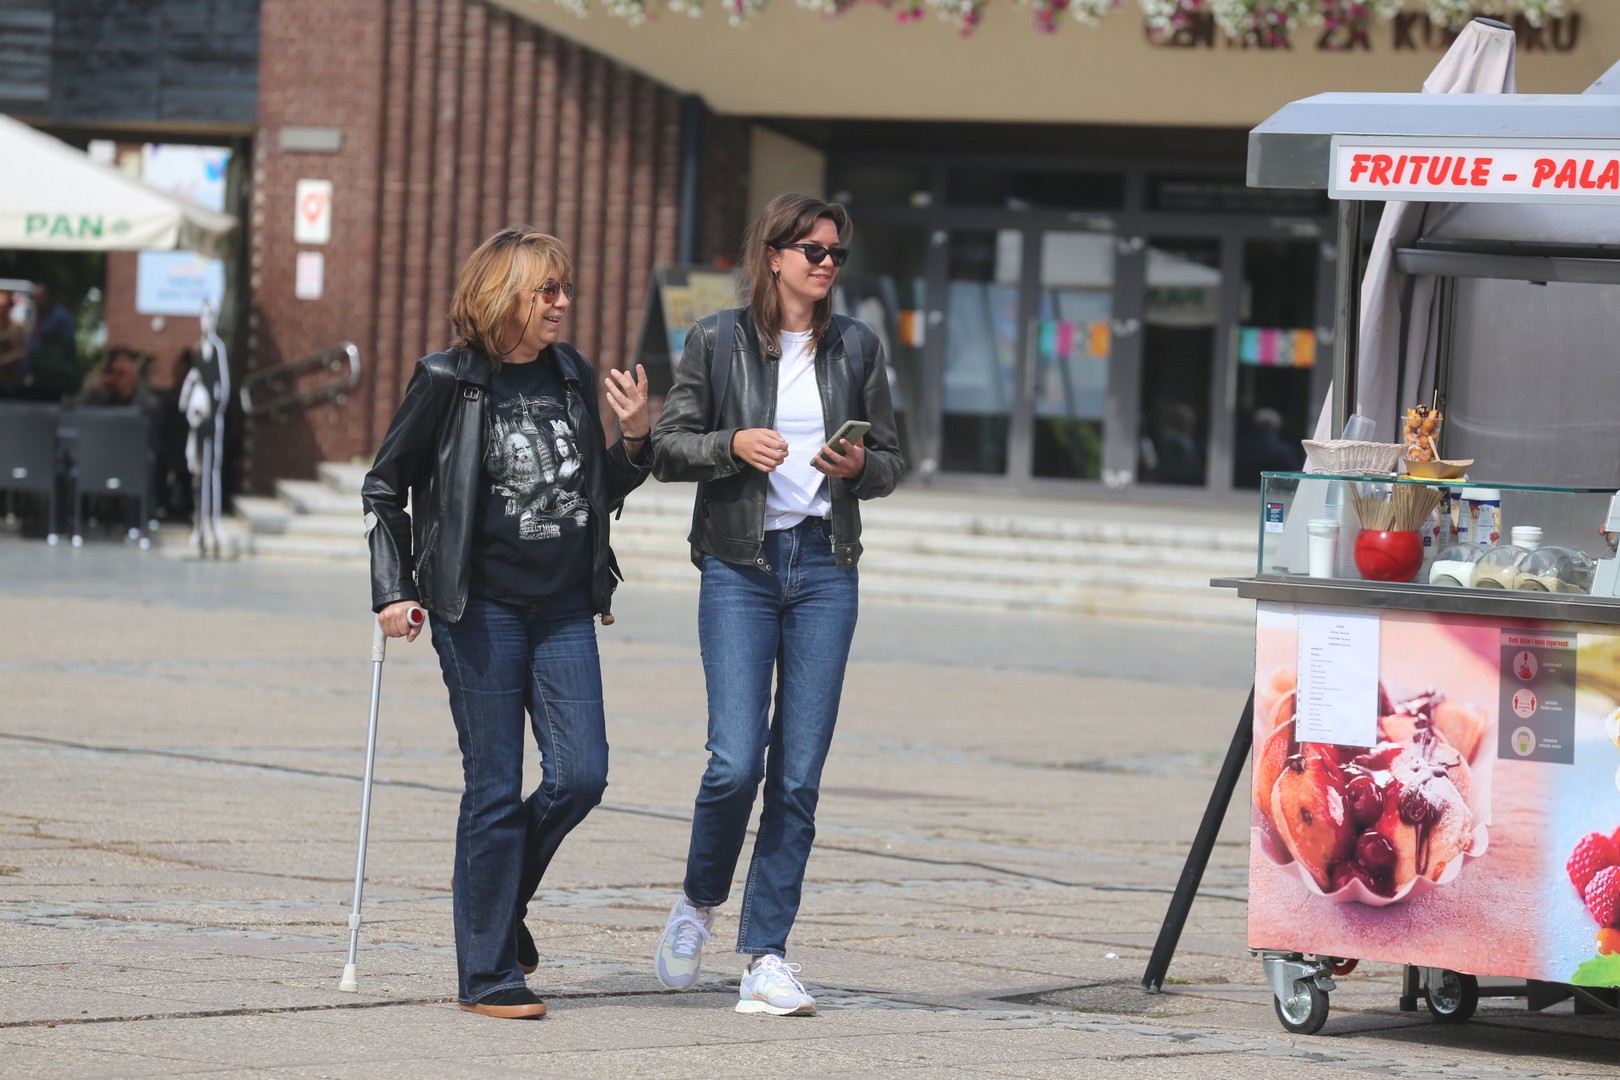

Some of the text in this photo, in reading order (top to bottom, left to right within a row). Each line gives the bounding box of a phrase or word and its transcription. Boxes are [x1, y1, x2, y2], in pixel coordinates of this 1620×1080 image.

[1349, 153, 1620, 190] FRITULE - PALA
[25, 213, 104, 238] PAN
